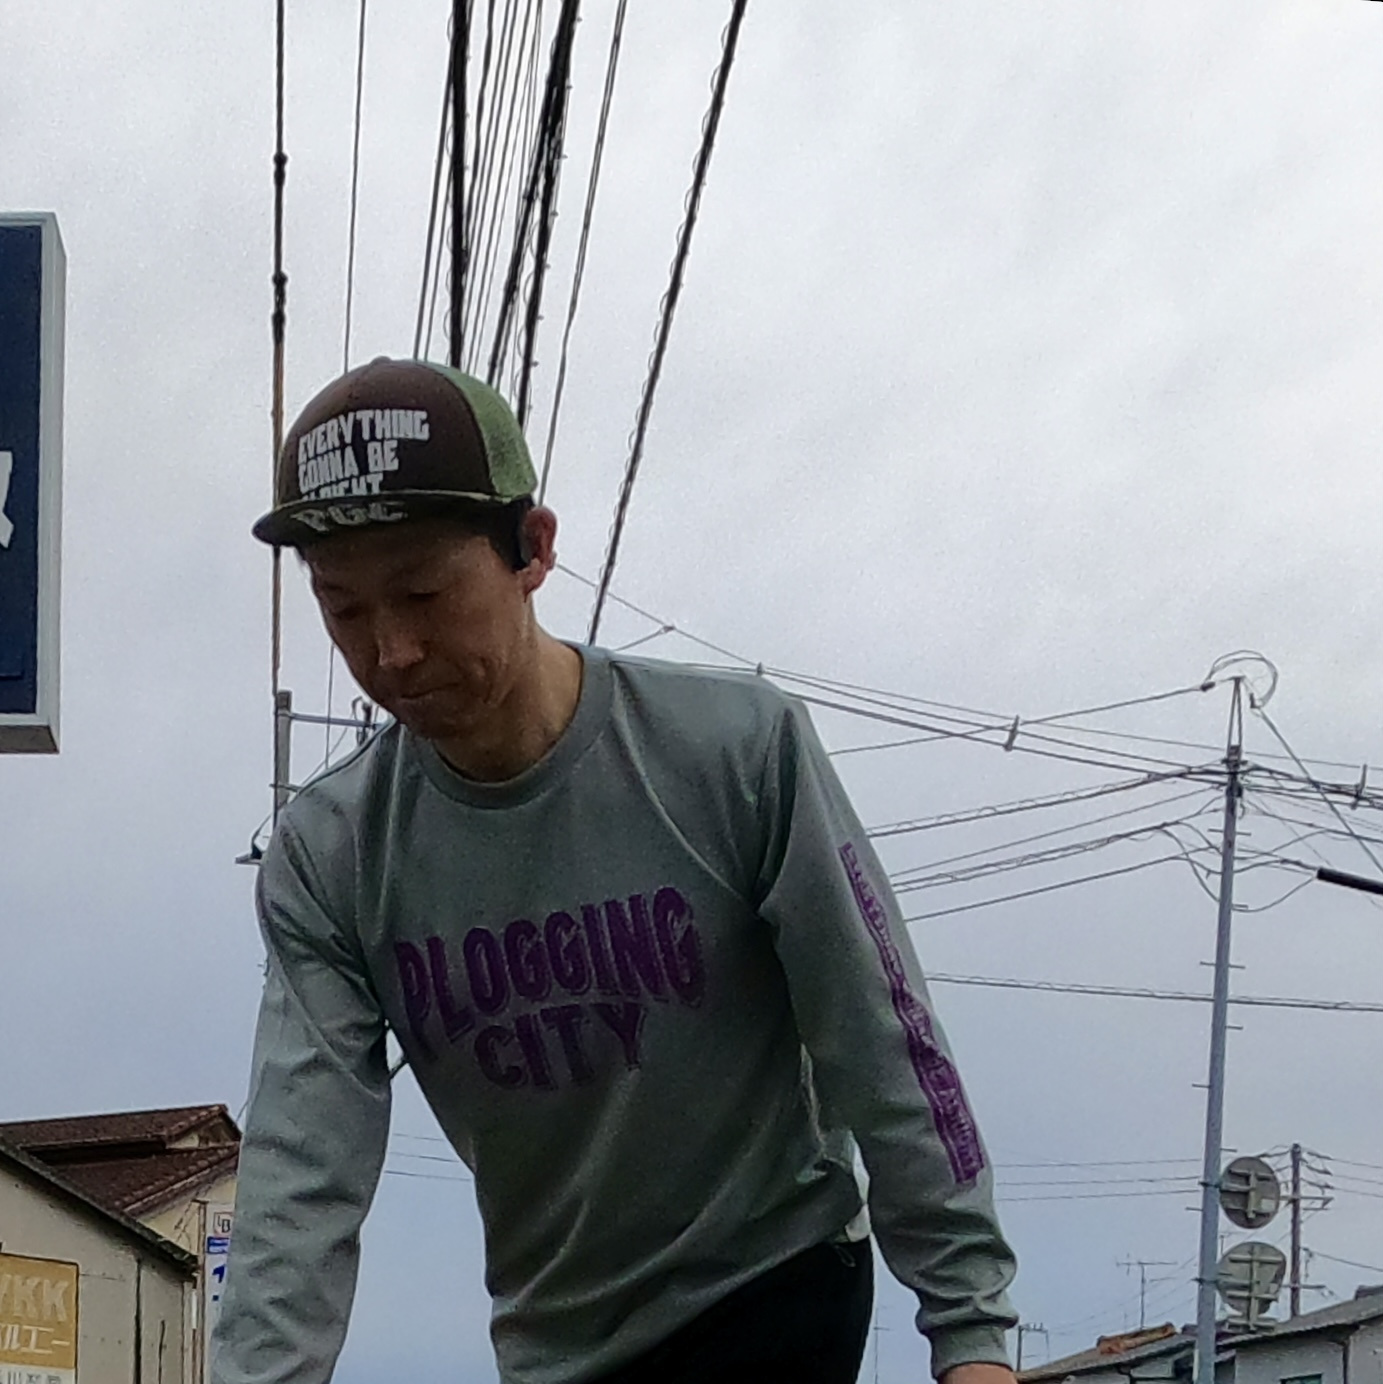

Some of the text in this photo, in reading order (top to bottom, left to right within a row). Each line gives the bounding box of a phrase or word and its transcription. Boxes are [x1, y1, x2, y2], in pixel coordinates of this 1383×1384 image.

[297, 408, 430, 465] EVERYTHING
[298, 439, 399, 495] GONNA BE
[393, 887, 705, 1060] PLOGGING
[474, 1000, 647, 1090] CITY
